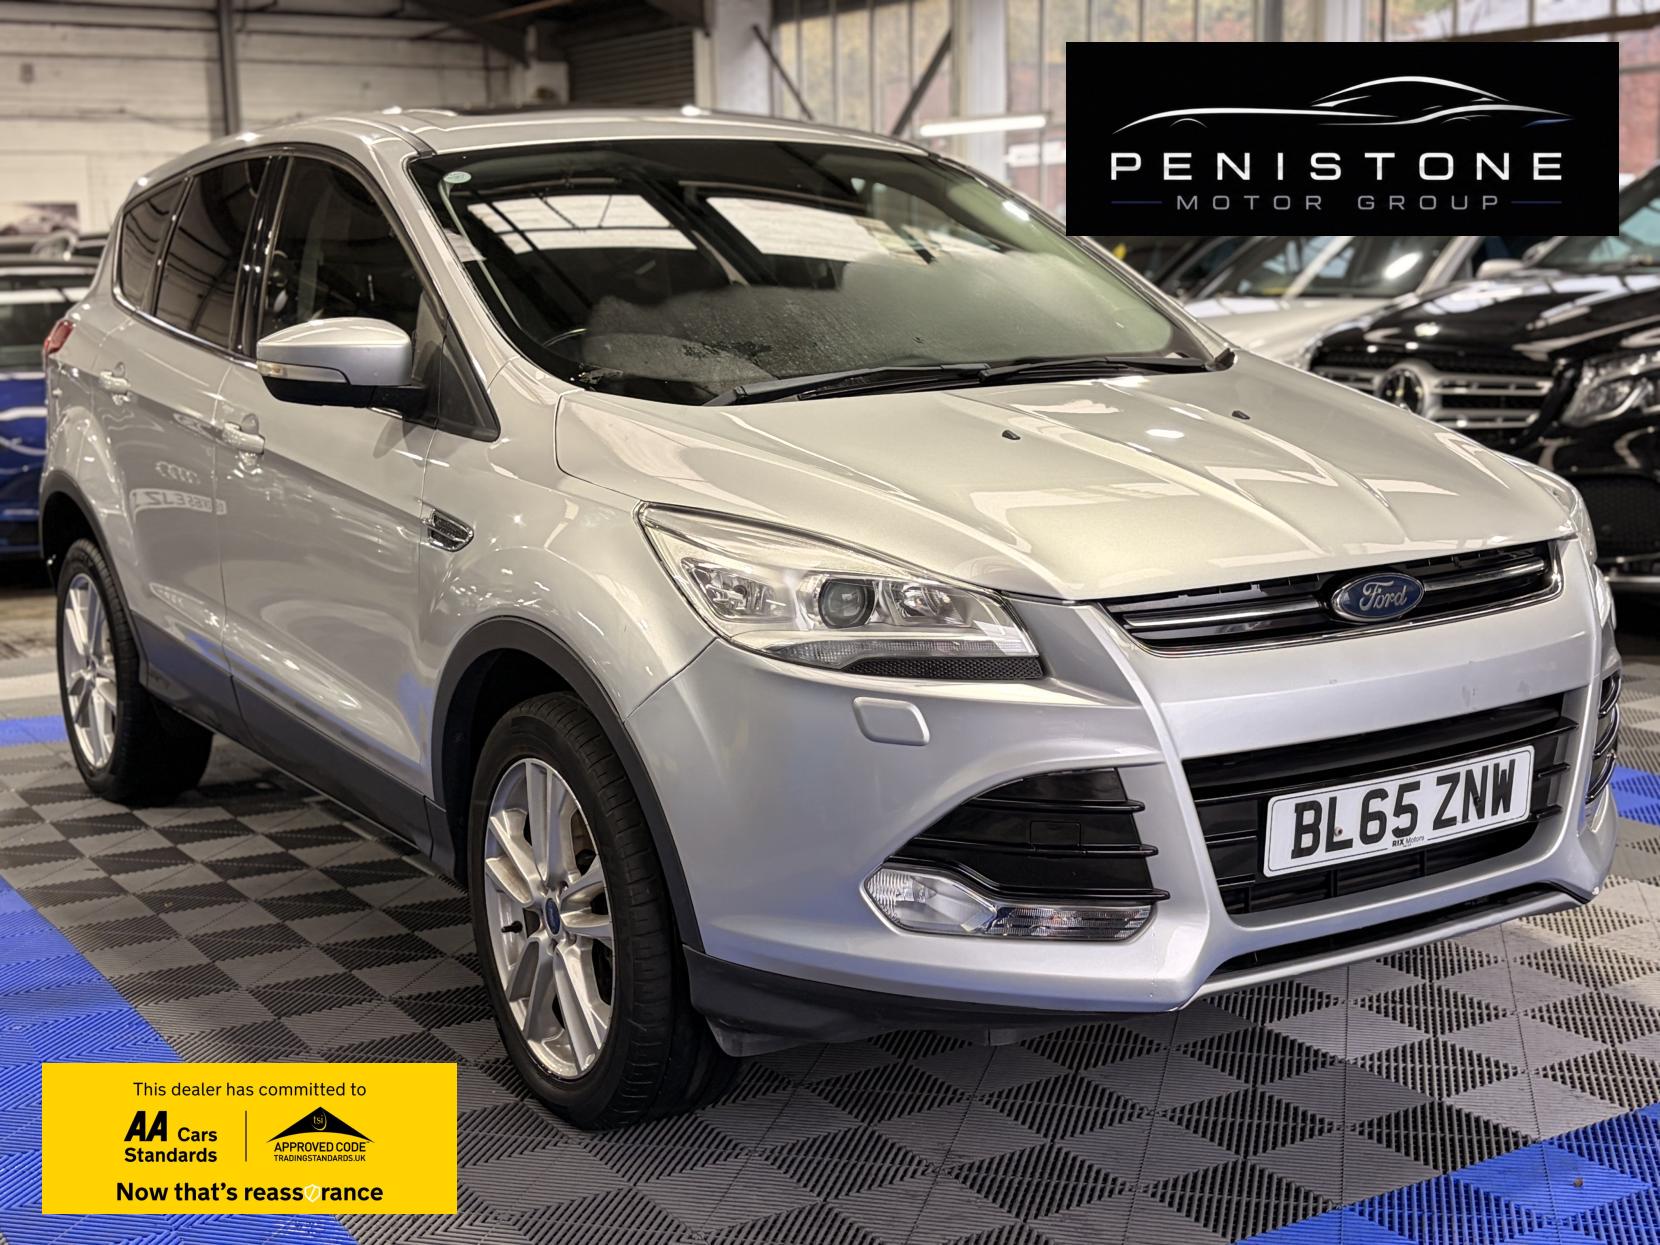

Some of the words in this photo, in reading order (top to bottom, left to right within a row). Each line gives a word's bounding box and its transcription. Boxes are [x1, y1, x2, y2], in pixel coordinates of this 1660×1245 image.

[1359, 581, 1408, 611] Ford
[1291, 780, 1421, 860] BL65
[1432, 759, 1516, 831] ZNW
